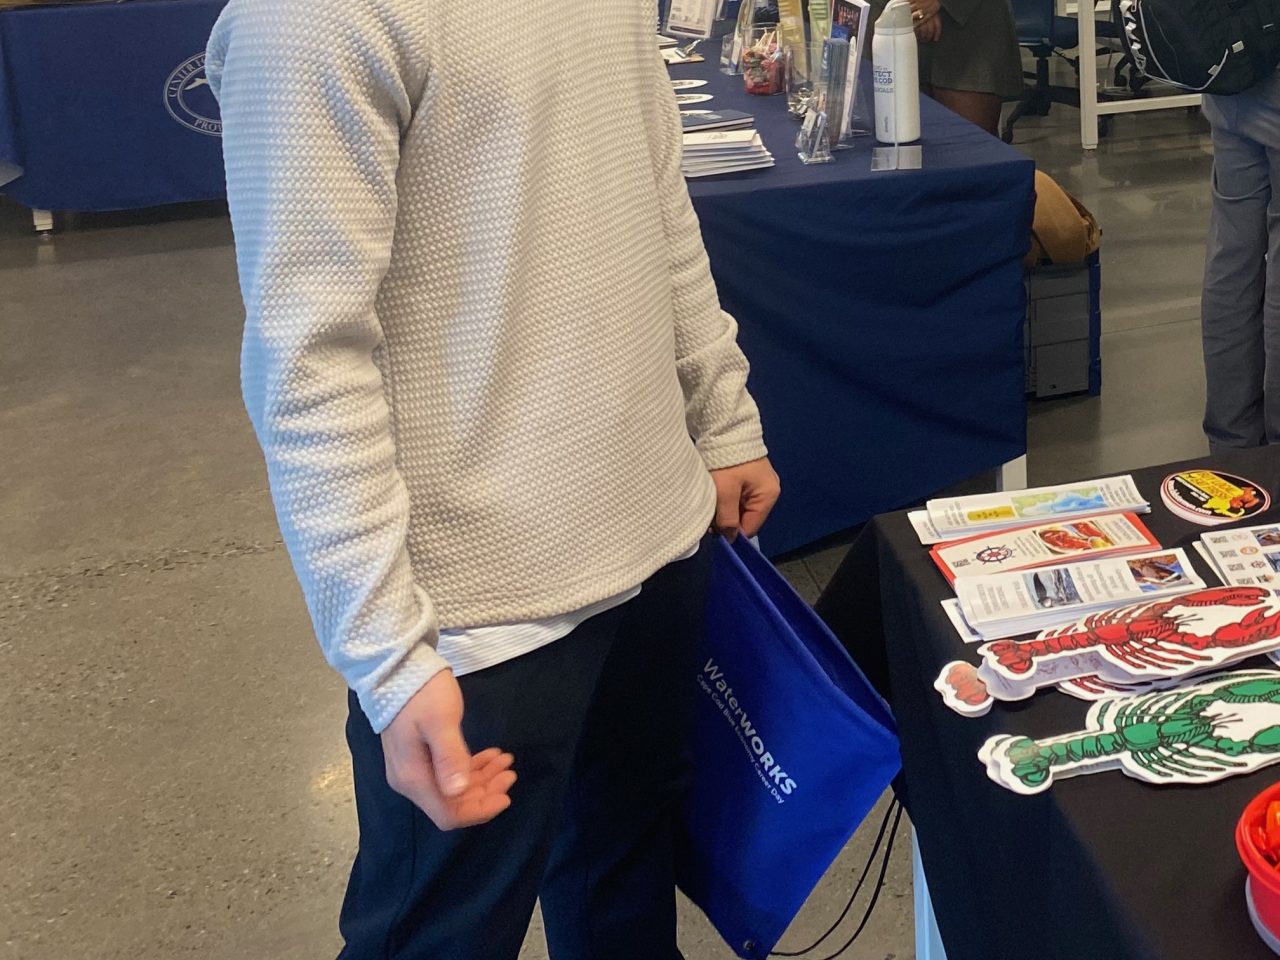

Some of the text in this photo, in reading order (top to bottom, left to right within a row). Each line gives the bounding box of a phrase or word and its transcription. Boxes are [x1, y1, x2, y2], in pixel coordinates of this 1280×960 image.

[168, 63, 196, 98] CENTER
[712, 692, 725, 710] Cod
[755, 762, 772, 789] Career
[770, 787, 785, 804] Day
